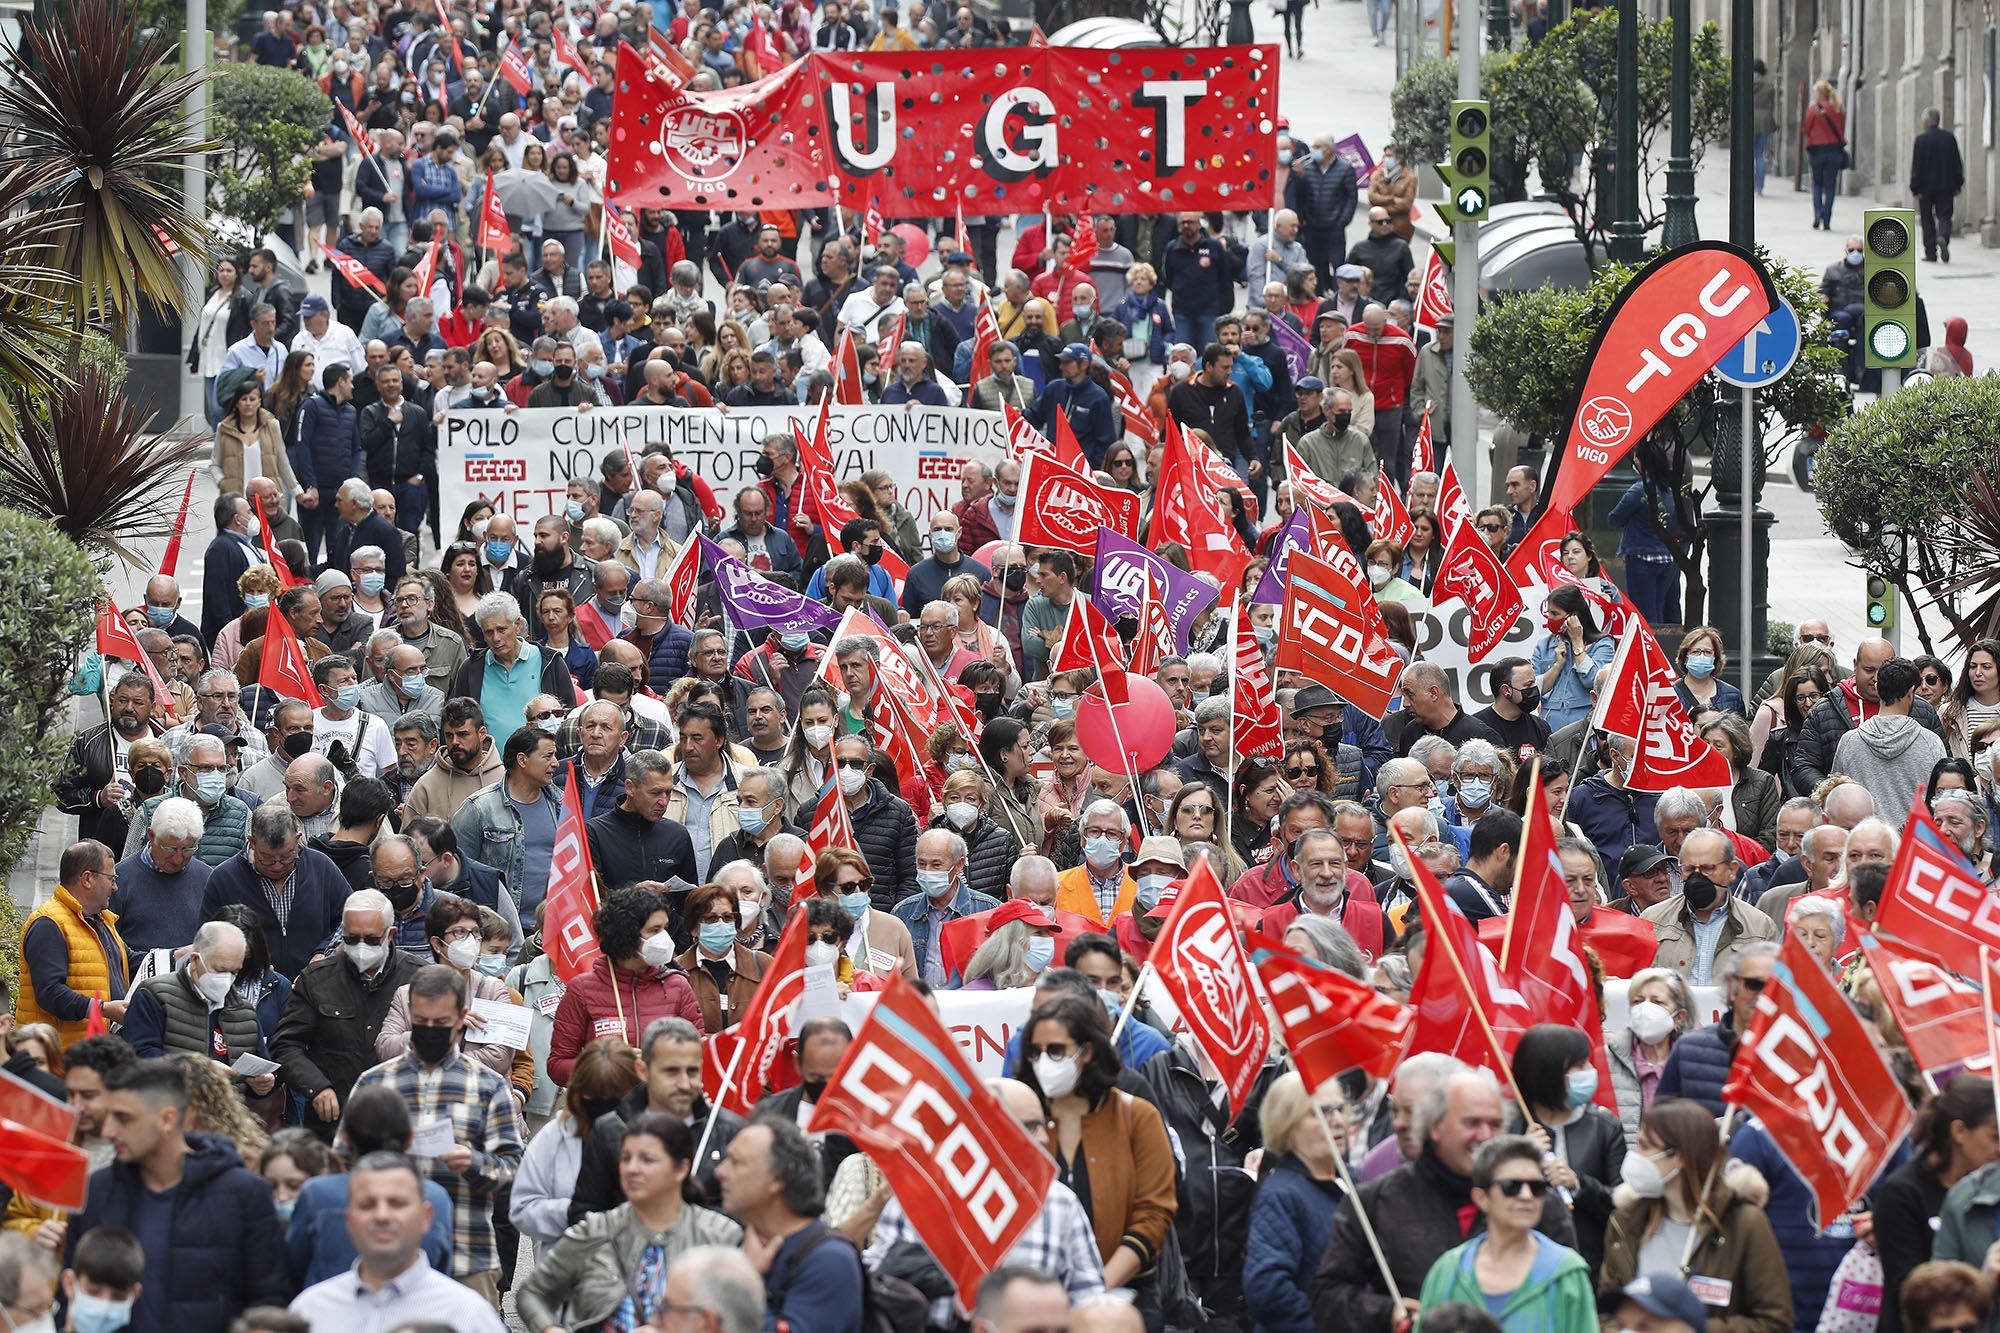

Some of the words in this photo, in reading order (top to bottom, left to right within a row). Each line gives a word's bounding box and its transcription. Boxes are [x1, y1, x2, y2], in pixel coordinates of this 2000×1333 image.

[678, 112, 732, 139] UGT
[830, 80, 1208, 172] UGT
[686, 180, 728, 194] VIGO
[1625, 267, 1751, 394] UGT
[448, 417, 519, 447] POLO
[552, 415, 768, 446] CUMPLIMENTO
[852, 413, 1007, 448] CONVENIOS
[465, 460, 526, 481] CCOO
[550, 449, 594, 482] NO
[919, 458, 968, 479] CCO
[1576, 444, 1609, 466] VIGO
[1049, 479, 1103, 519] UGT
[1744, 994, 1869, 1175] COO
[840, 1041, 1019, 1244] CCOO
